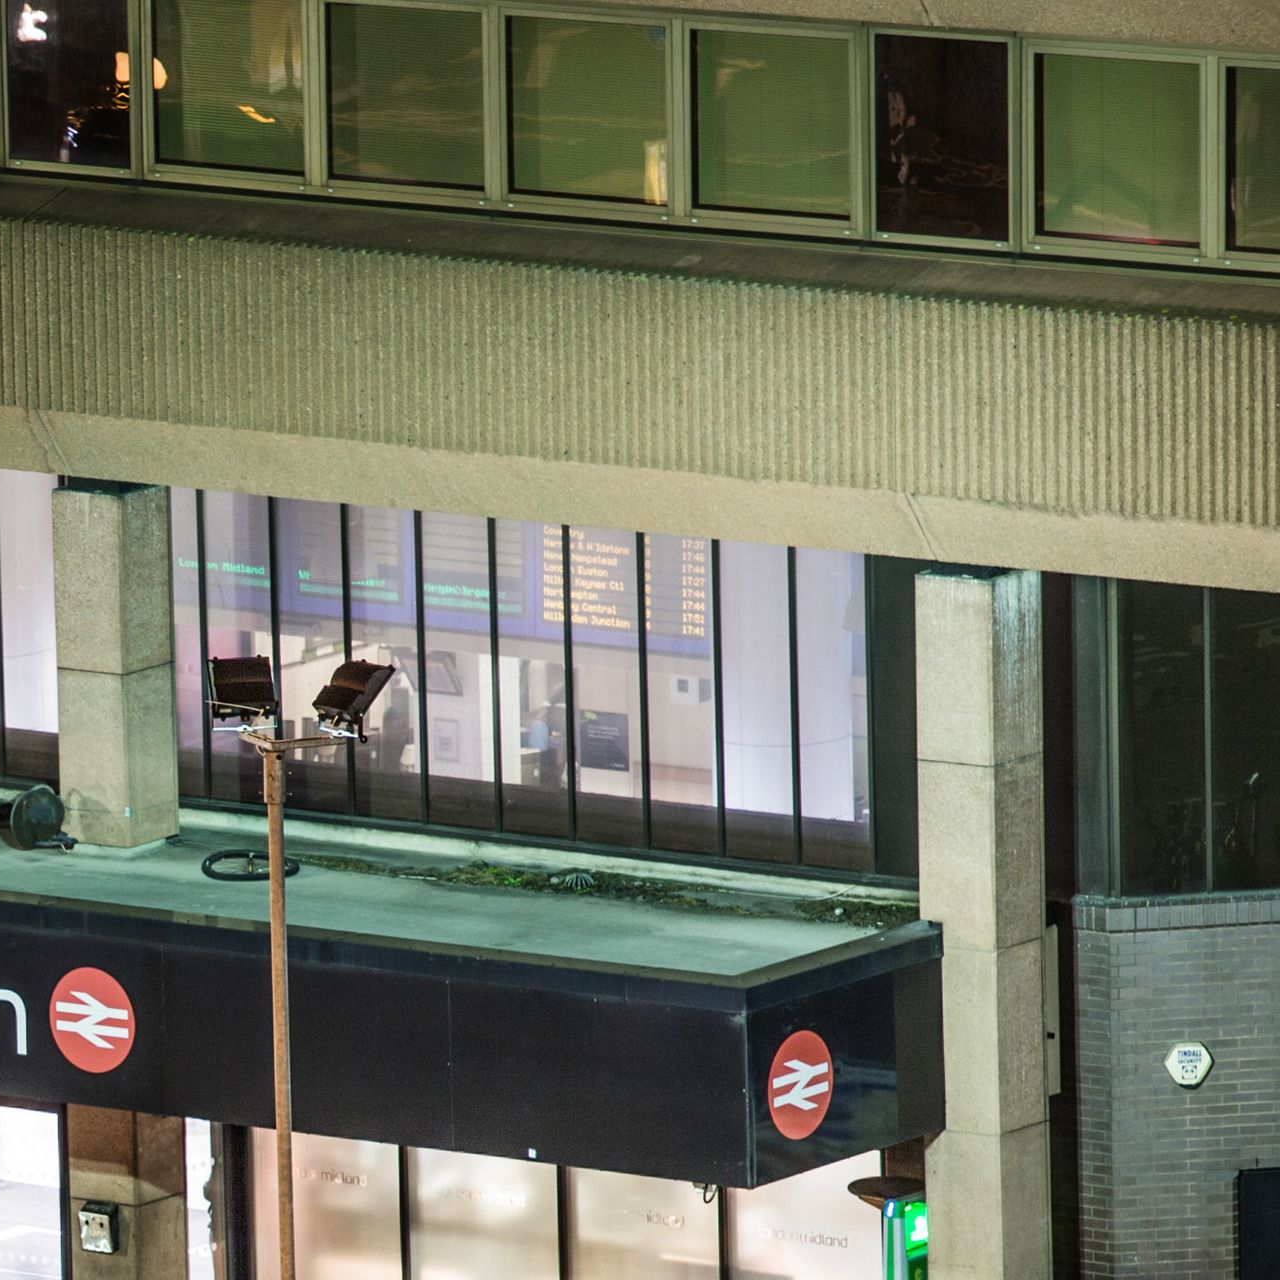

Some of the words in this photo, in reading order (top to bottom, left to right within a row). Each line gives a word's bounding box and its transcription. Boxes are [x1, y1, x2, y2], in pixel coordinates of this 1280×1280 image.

[544, 525, 584, 540] Covetry
[544, 537, 574, 551] Harrw
[178, 557, 218, 571] Lonon
